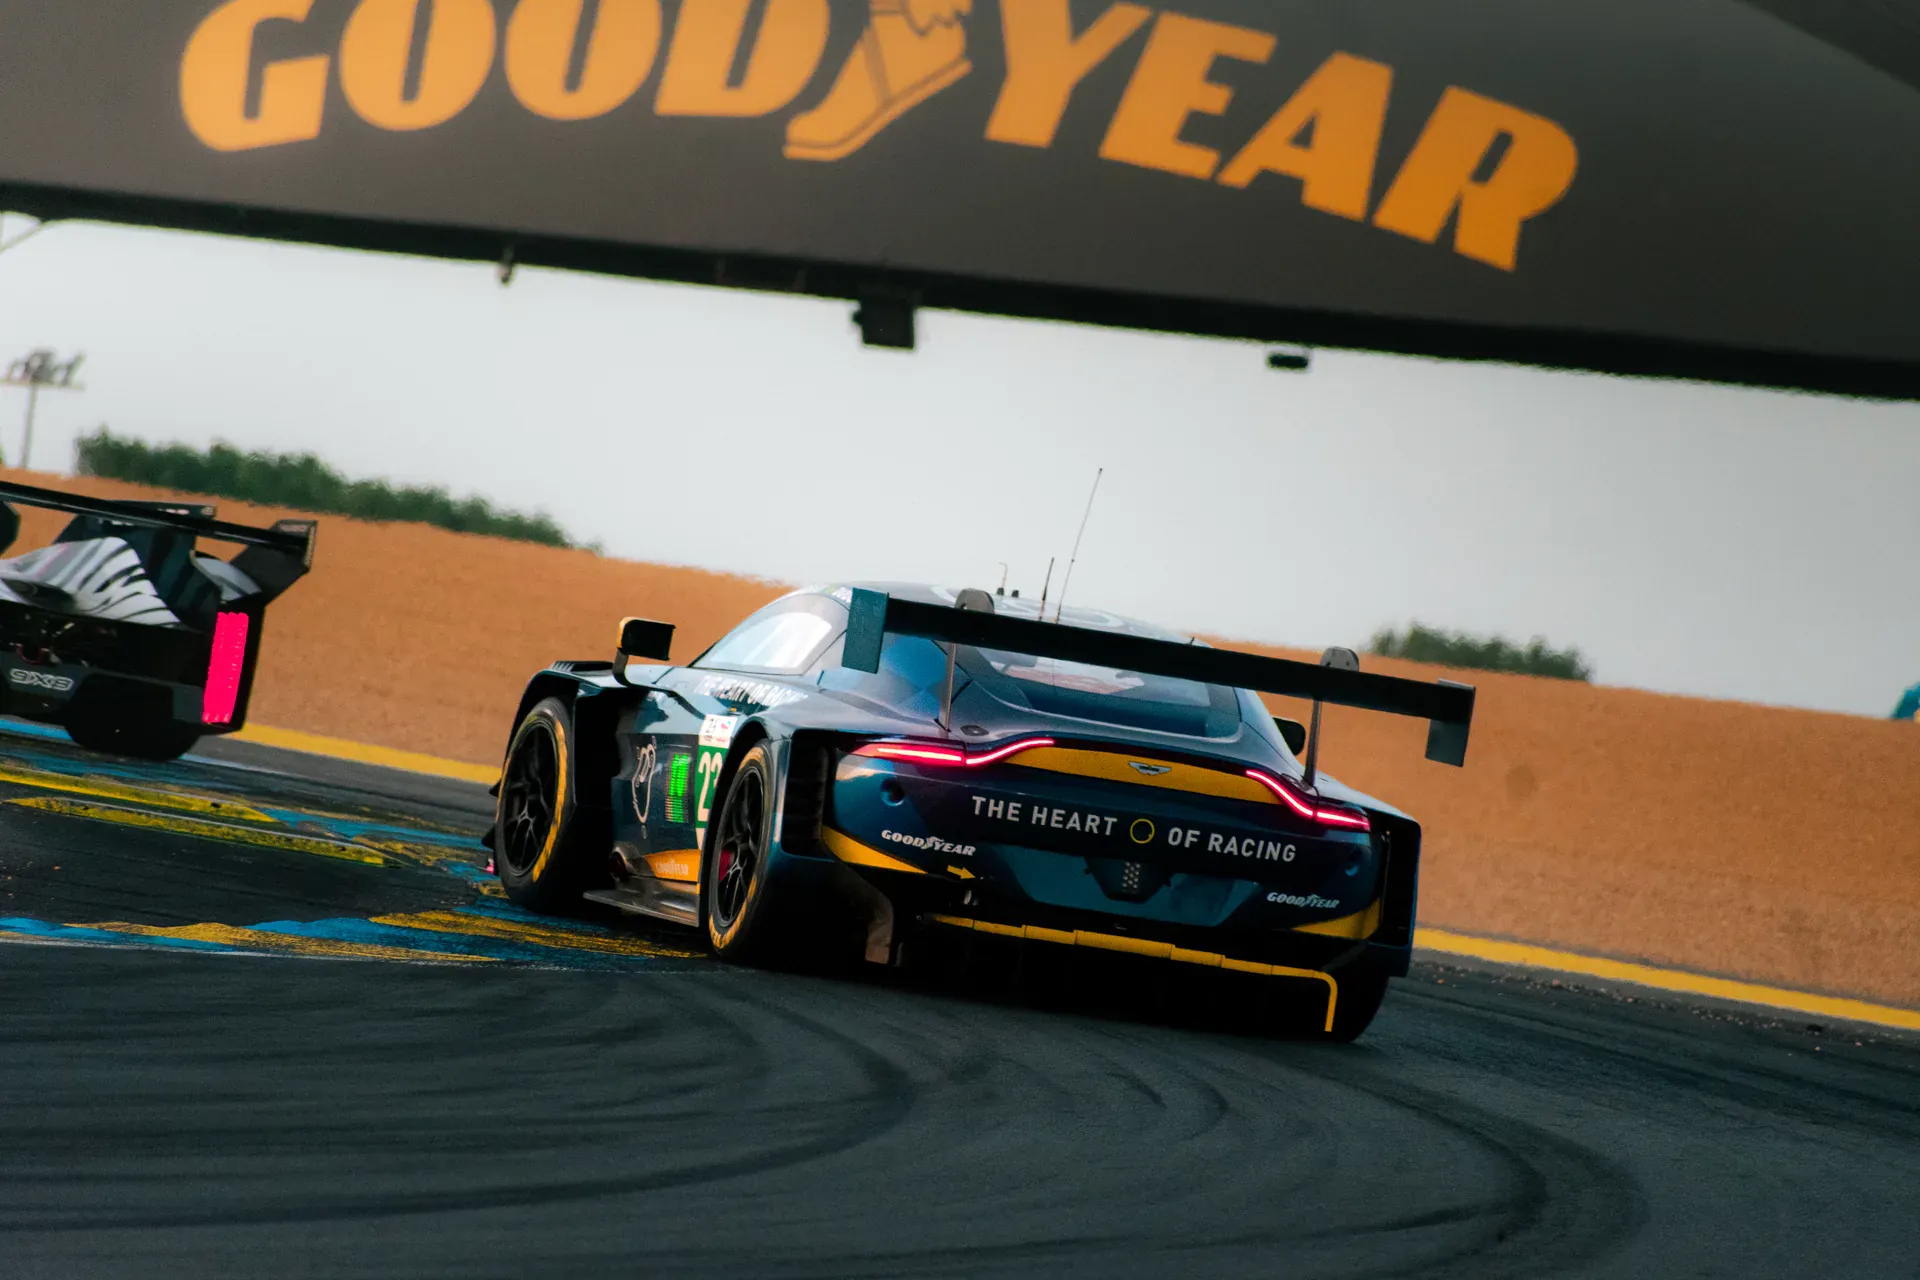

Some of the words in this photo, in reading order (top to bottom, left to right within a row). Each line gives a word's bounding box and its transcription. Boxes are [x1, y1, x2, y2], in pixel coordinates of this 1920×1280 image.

[180, 0, 1579, 270] GOODYEAR
[10, 667, 74, 691] 9X8
[881, 829, 976, 856] GOODYEAR
[971, 796, 1022, 822] THE
[1031, 805, 1118, 836] HEART
[1167, 827, 1200, 848] OF
[1207, 833, 1296, 862] RACING
[1266, 892, 1340, 909] GOODYEAR
